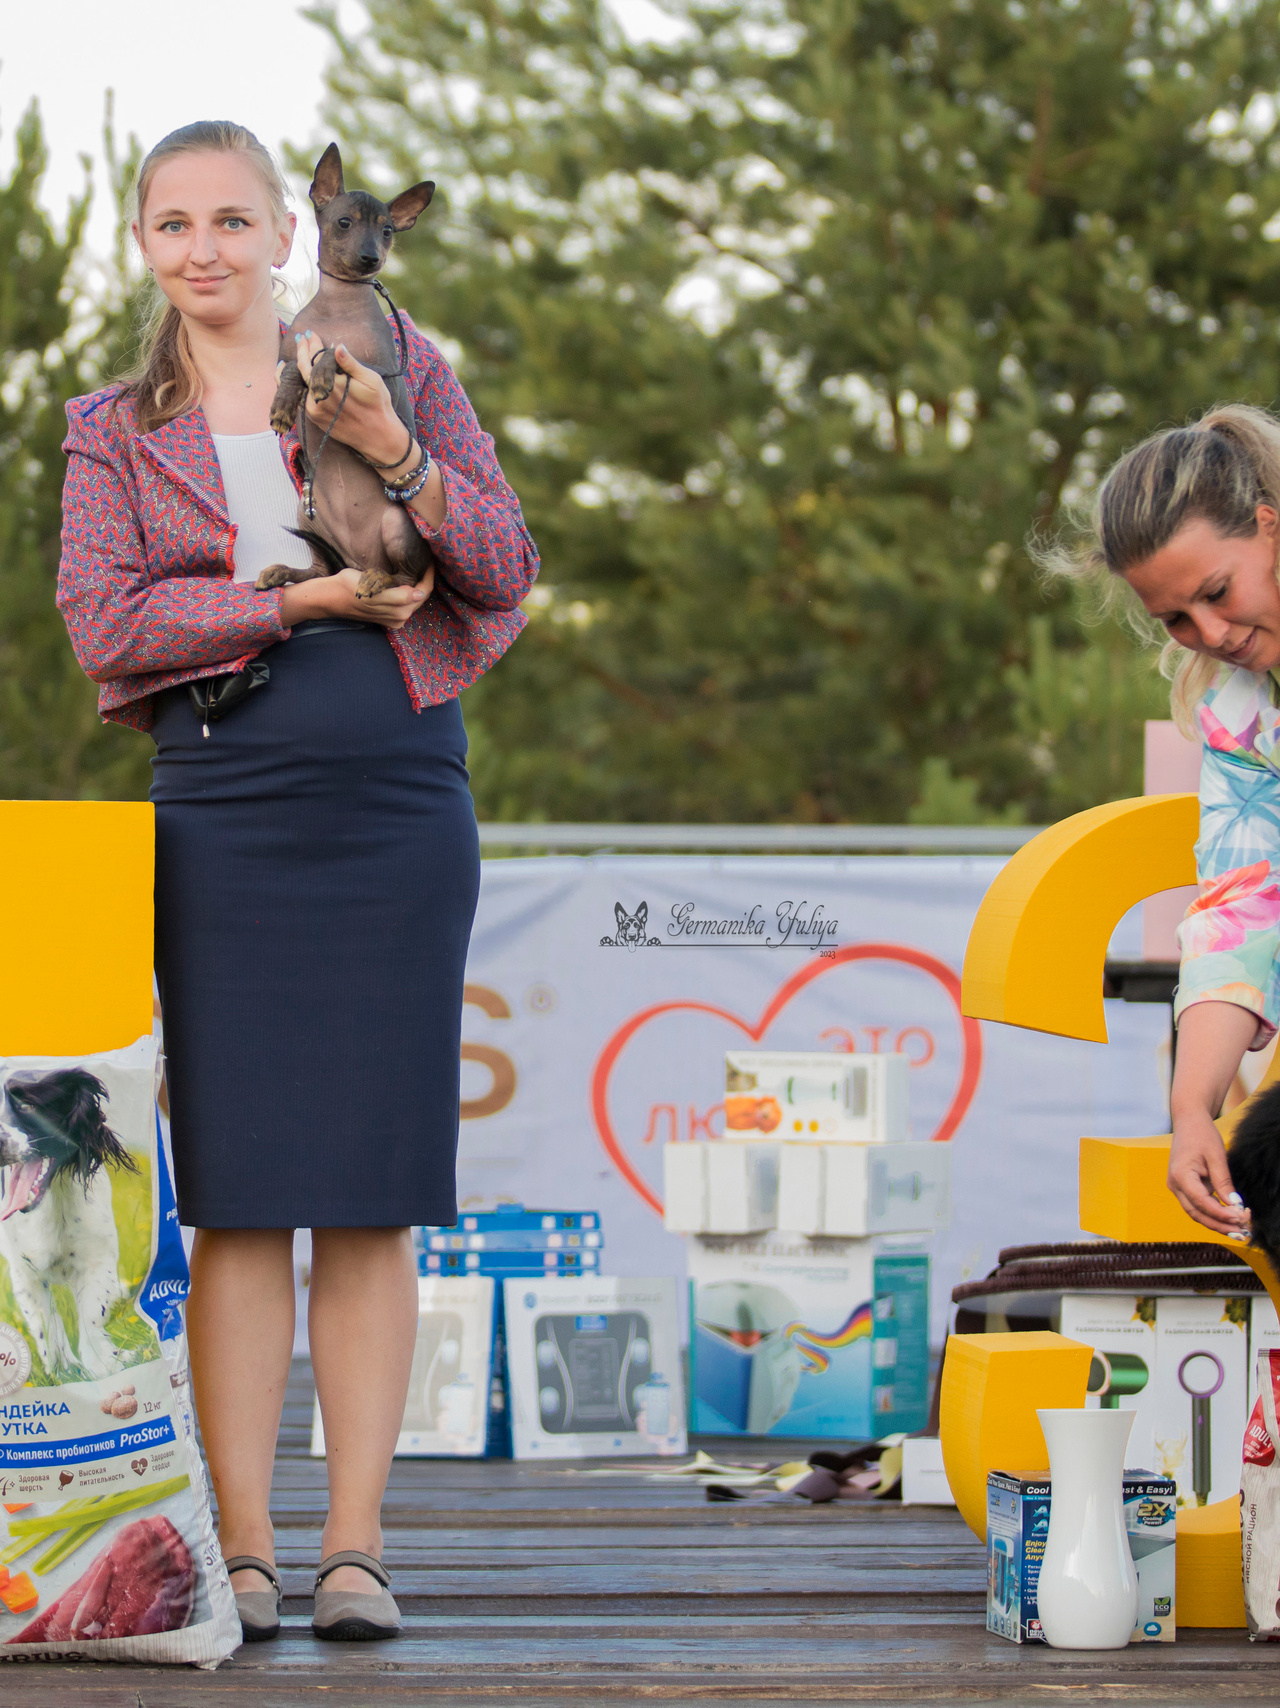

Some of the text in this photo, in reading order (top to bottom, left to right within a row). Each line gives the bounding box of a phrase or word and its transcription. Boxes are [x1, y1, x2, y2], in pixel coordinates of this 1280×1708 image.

[143, 1403, 154, 1414] 12
[1, 1422, 48, 1437] УТКА
[120, 1424, 170, 1448] ProStor+
[6, 1439, 116, 1461] Комплекс пробиотиков
[150, 1450, 175, 1463] Здоровое
[78, 1466, 107, 1477] Высокая
[152, 1461, 171, 1472] сердце
[19, 1474, 50, 1484] Здоровая
[79, 1473, 125, 1487] питательность
[19, 1484, 44, 1493] шерсть
[1026, 1486, 1050, 1494] Cool
[1136, 1486, 1143, 1494] &
[1146, 1486, 1173, 1495] Easy!
[1137, 1502, 1171, 1517] 2X
[1247, 1503, 1257, 1541] РАЦИОН
